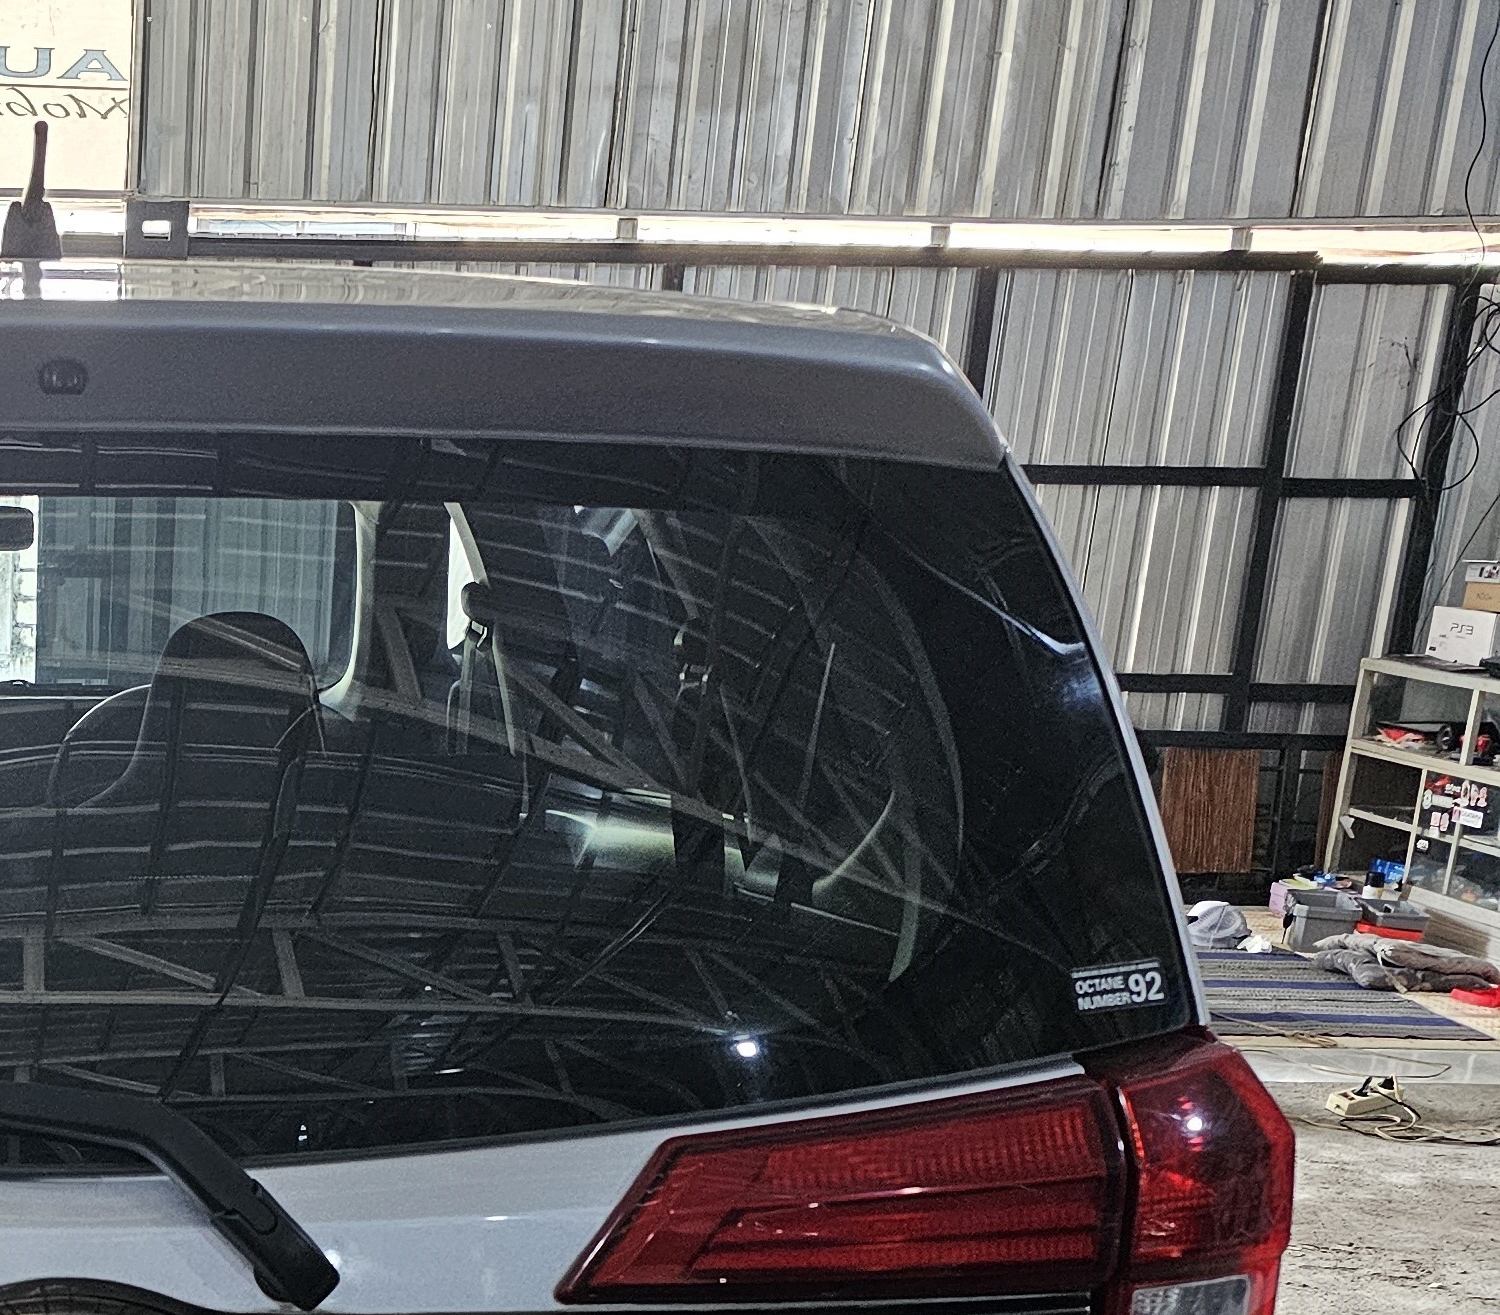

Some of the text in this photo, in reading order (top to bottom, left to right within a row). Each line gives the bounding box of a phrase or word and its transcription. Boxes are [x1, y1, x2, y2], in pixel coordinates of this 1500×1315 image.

[1450, 622, 1474, 636] PS3
[1075, 975, 1126, 995] OCTANE
[1127, 970, 1165, 1003] 92
[1077, 991, 1132, 1011] NUMBER
